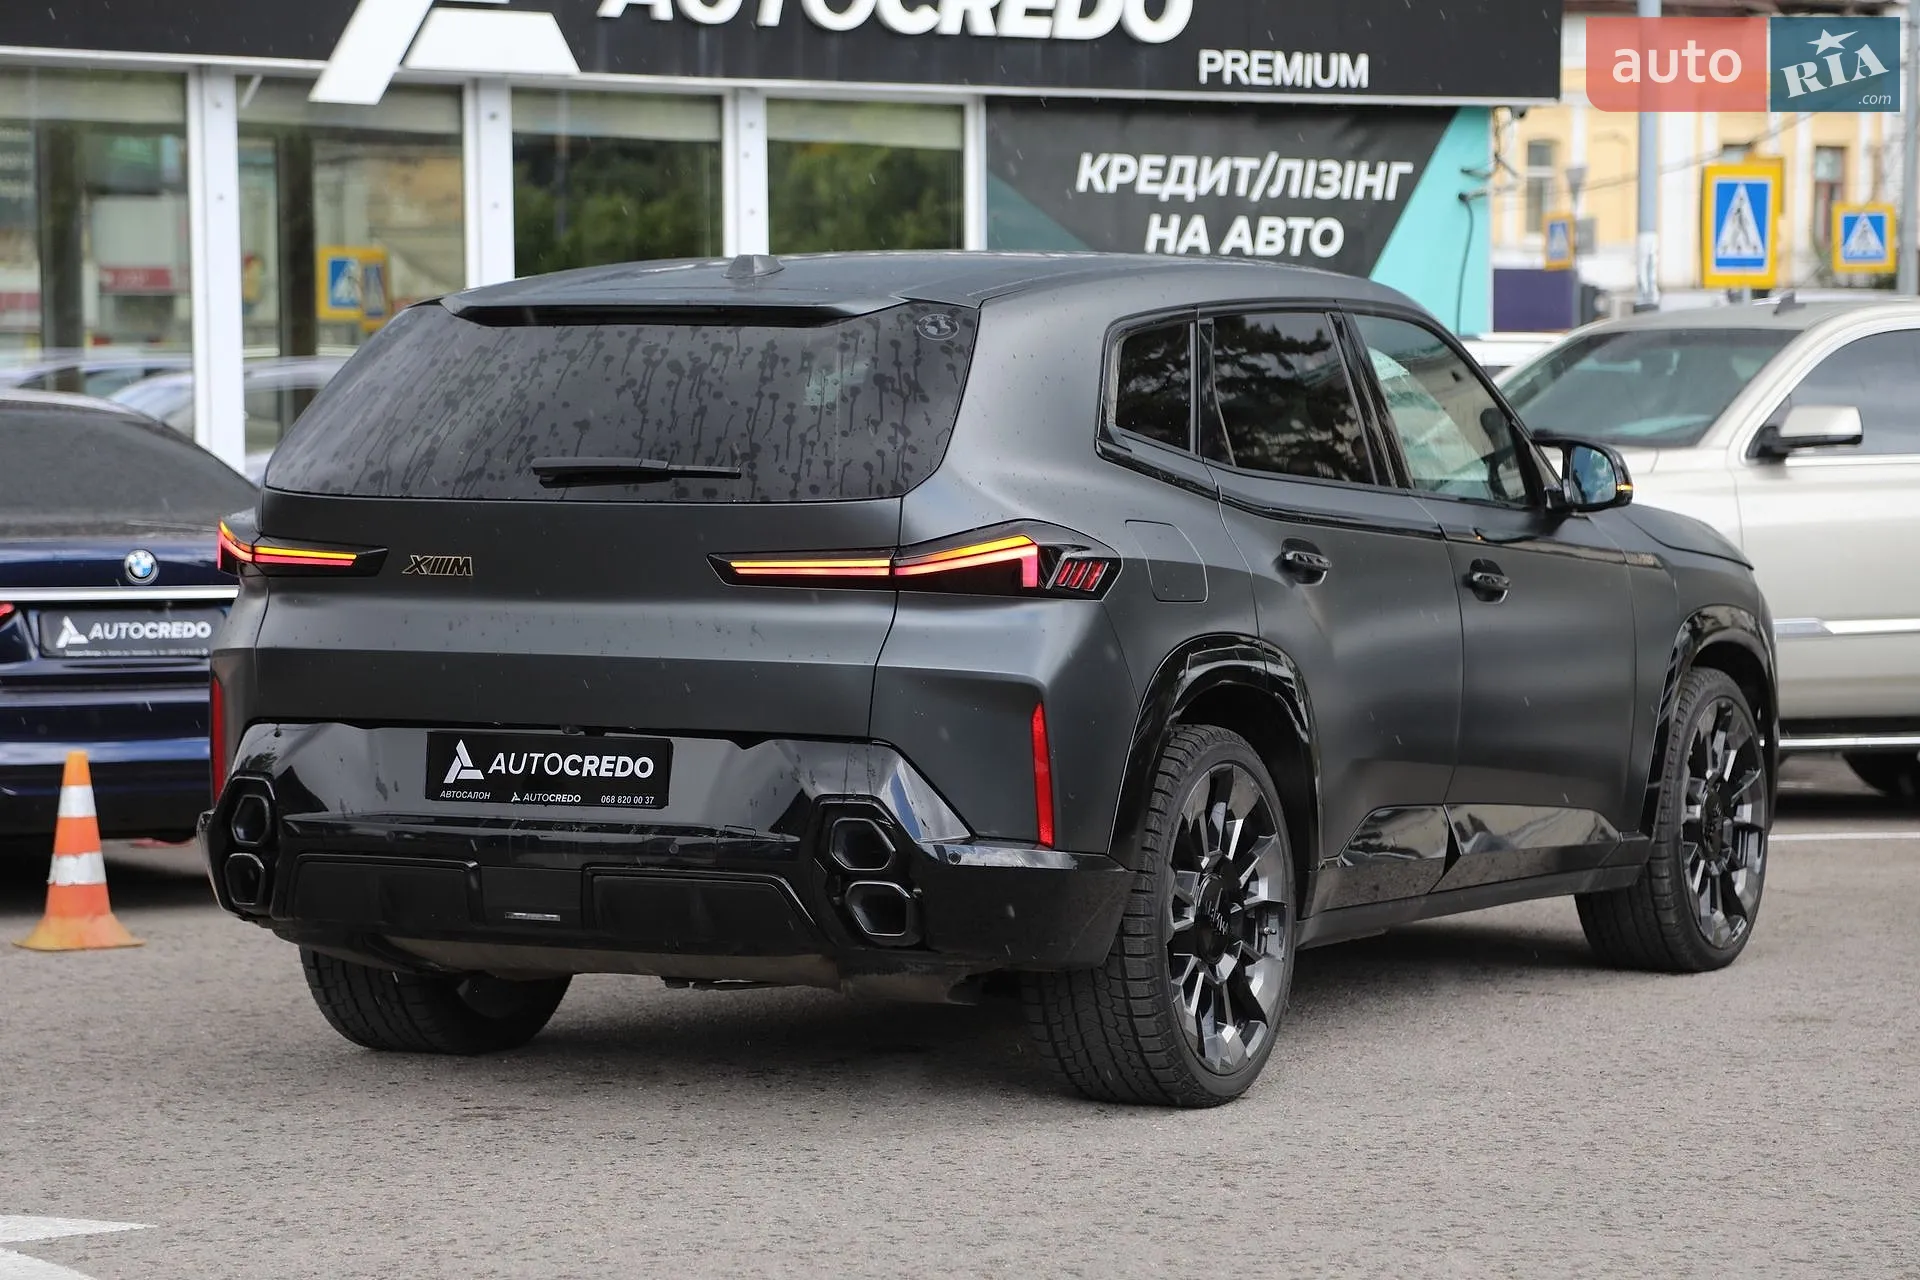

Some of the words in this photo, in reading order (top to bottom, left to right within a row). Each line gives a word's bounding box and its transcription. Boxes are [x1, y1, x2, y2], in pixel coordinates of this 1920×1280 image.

[597, 0, 1194, 44] CREDO
[1198, 49, 1370, 89] PREMIUM
[1076, 151, 1414, 203] КРЕДИТ/ЛІЗІНГ
[1144, 213, 1211, 255] НА
[1218, 215, 1345, 258] АВТО
[88, 621, 212, 640] AUTOCREDO
[488, 752, 654, 779] AUTOCREDO
[439, 790, 491, 800] АВТОСАЛОН
[523, 793, 582, 803] AUTOCREDO
[600, 795, 616, 804] 068
[617, 795, 632, 804] 820
[633, 796, 643, 805] 00
[644, 796, 655, 805] 37
